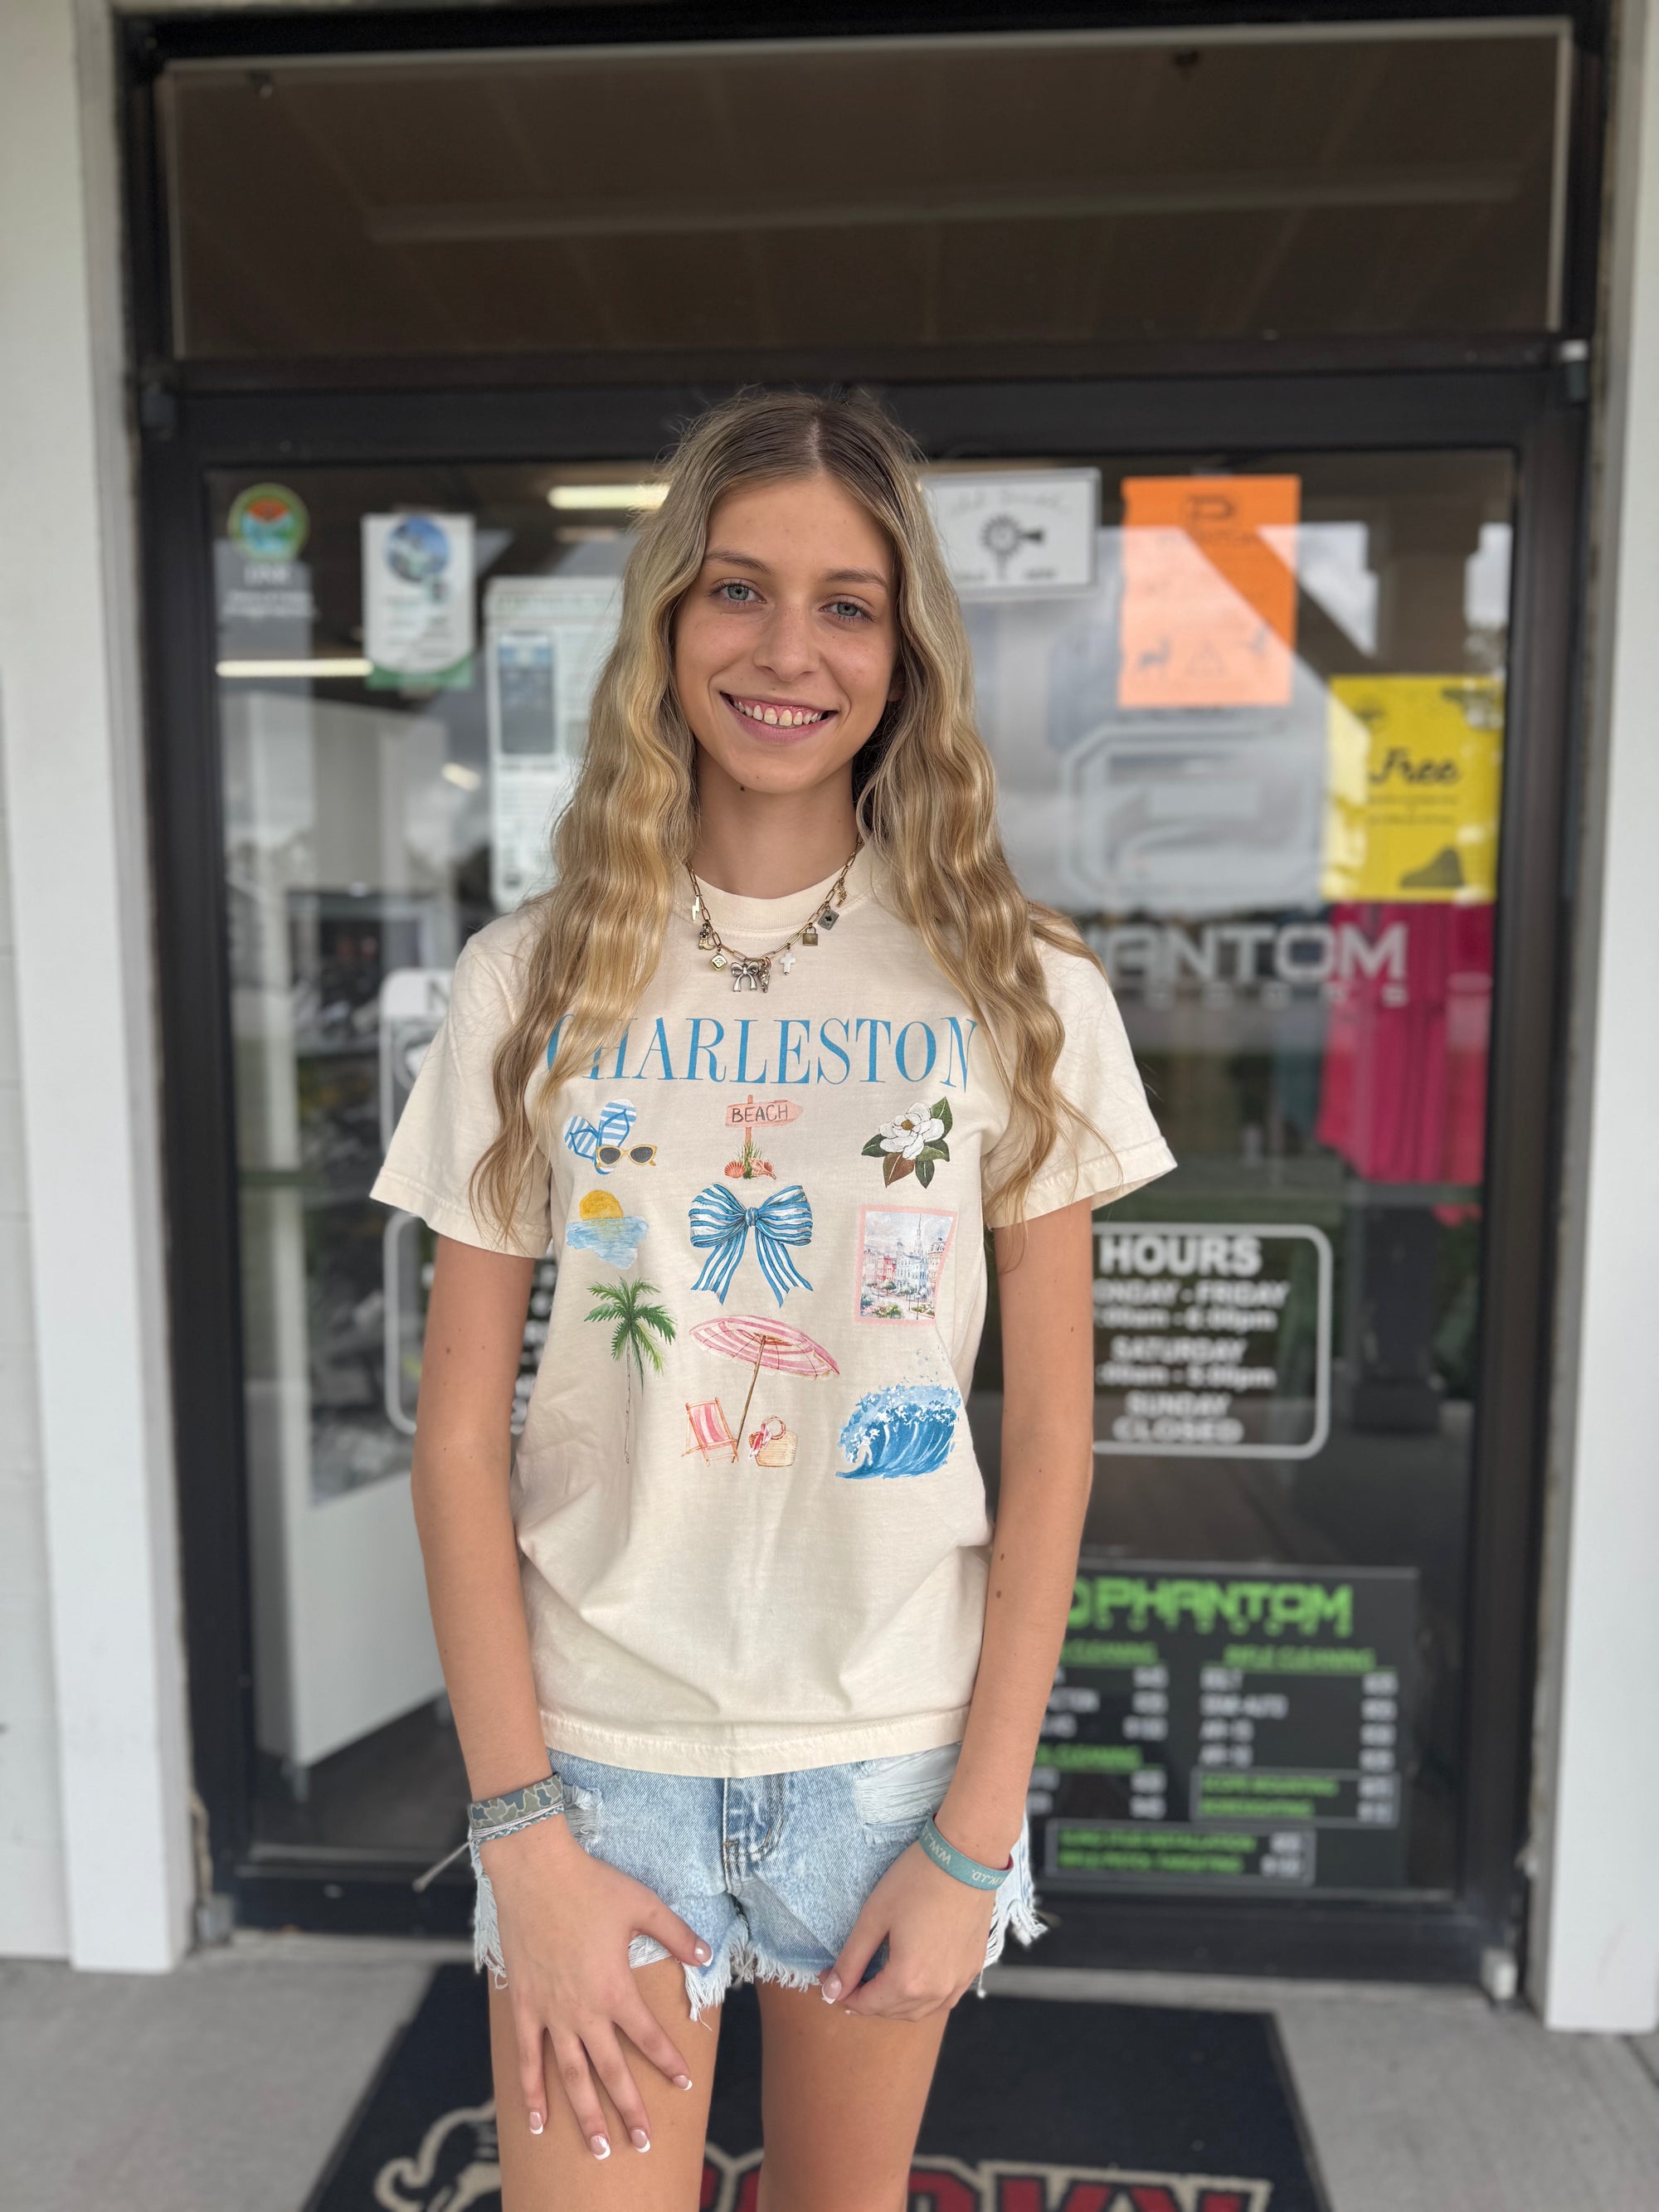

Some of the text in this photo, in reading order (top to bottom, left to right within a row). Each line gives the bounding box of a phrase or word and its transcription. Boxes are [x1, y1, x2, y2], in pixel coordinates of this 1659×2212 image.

[1369, 747, 1460, 785] Free
[732, 1104, 788, 1123] BEACH
[1099, 1235, 1262, 1276] HOURS
[1093, 1278, 1180, 1305] ONDAY
[1195, 1280, 1291, 1308] FRIDAY
[1111, 1335, 1248, 1364] SATURDAY
[1125, 1389, 1233, 1417] SUNDAY
[1112, 1416, 1244, 1444] CLOSED
[1094, 1577, 1354, 1627] PHANTOM
